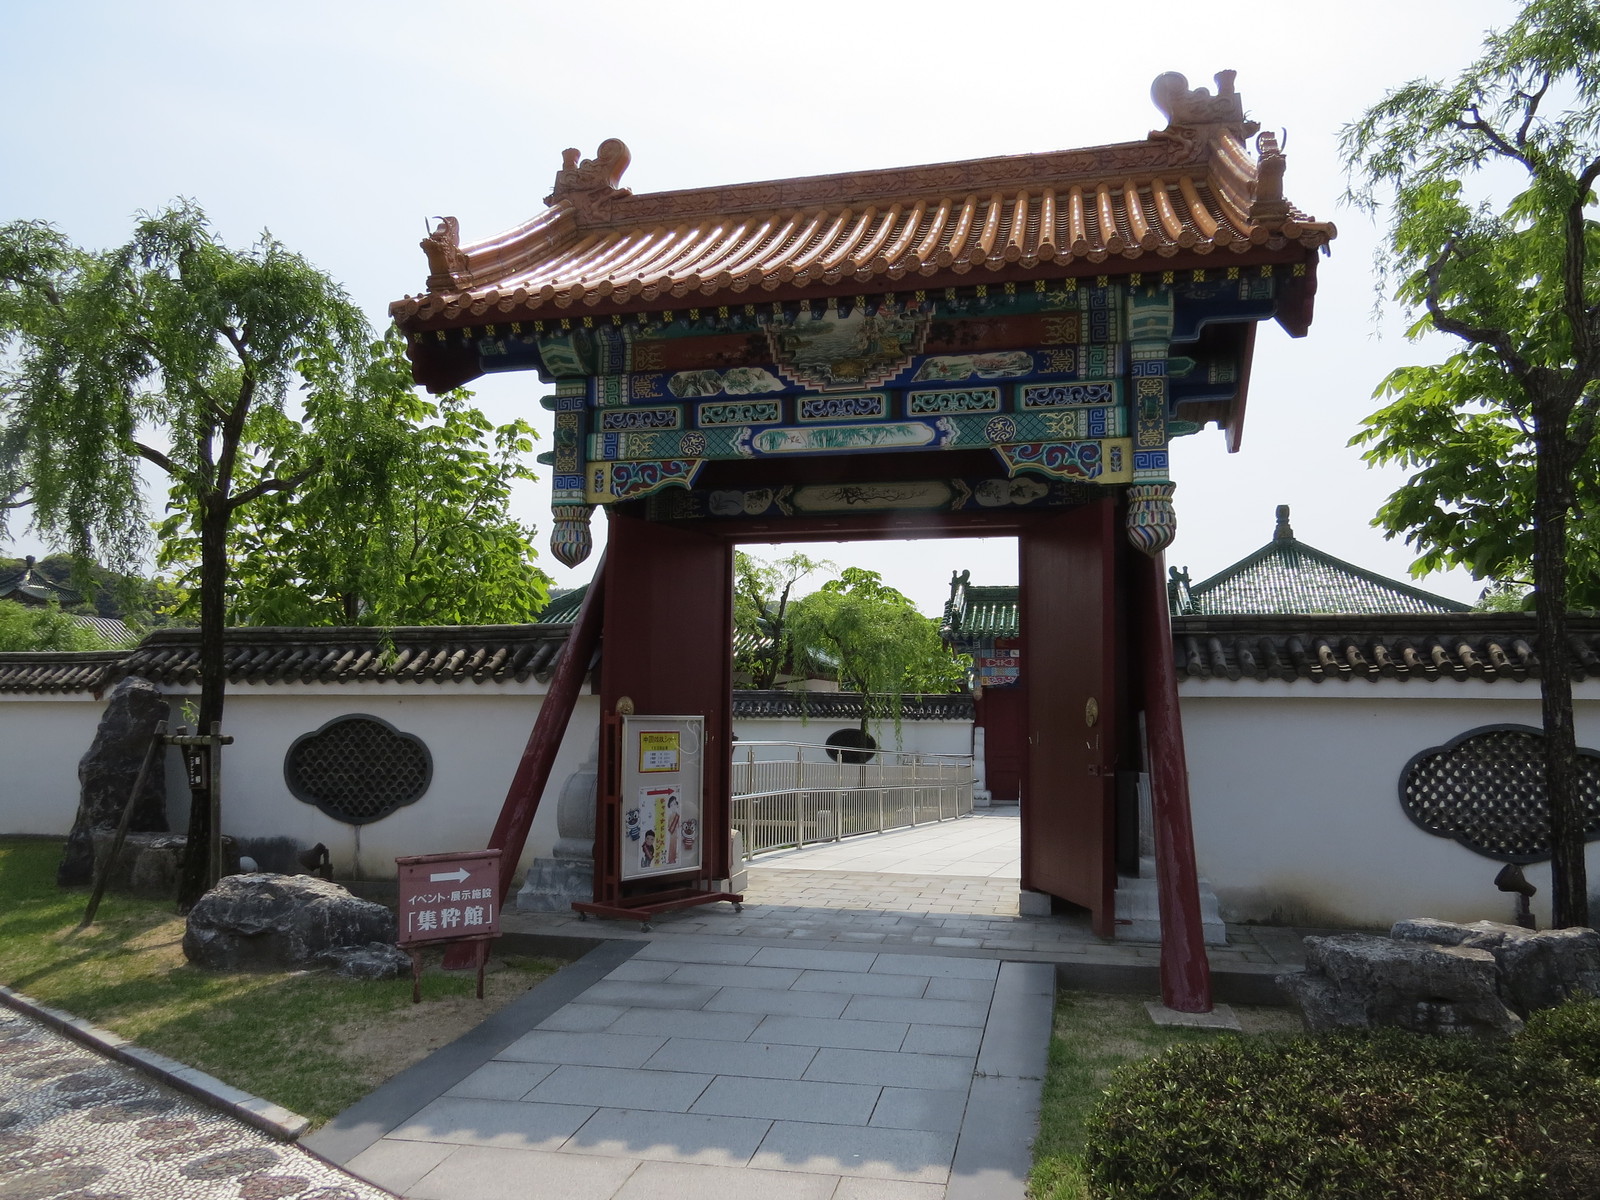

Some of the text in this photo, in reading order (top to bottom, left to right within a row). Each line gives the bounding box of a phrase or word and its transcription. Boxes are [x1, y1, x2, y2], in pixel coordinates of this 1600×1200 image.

[408, 888, 492, 905] イベント・展示施設
[408, 904, 493, 932] 「集粋館」
